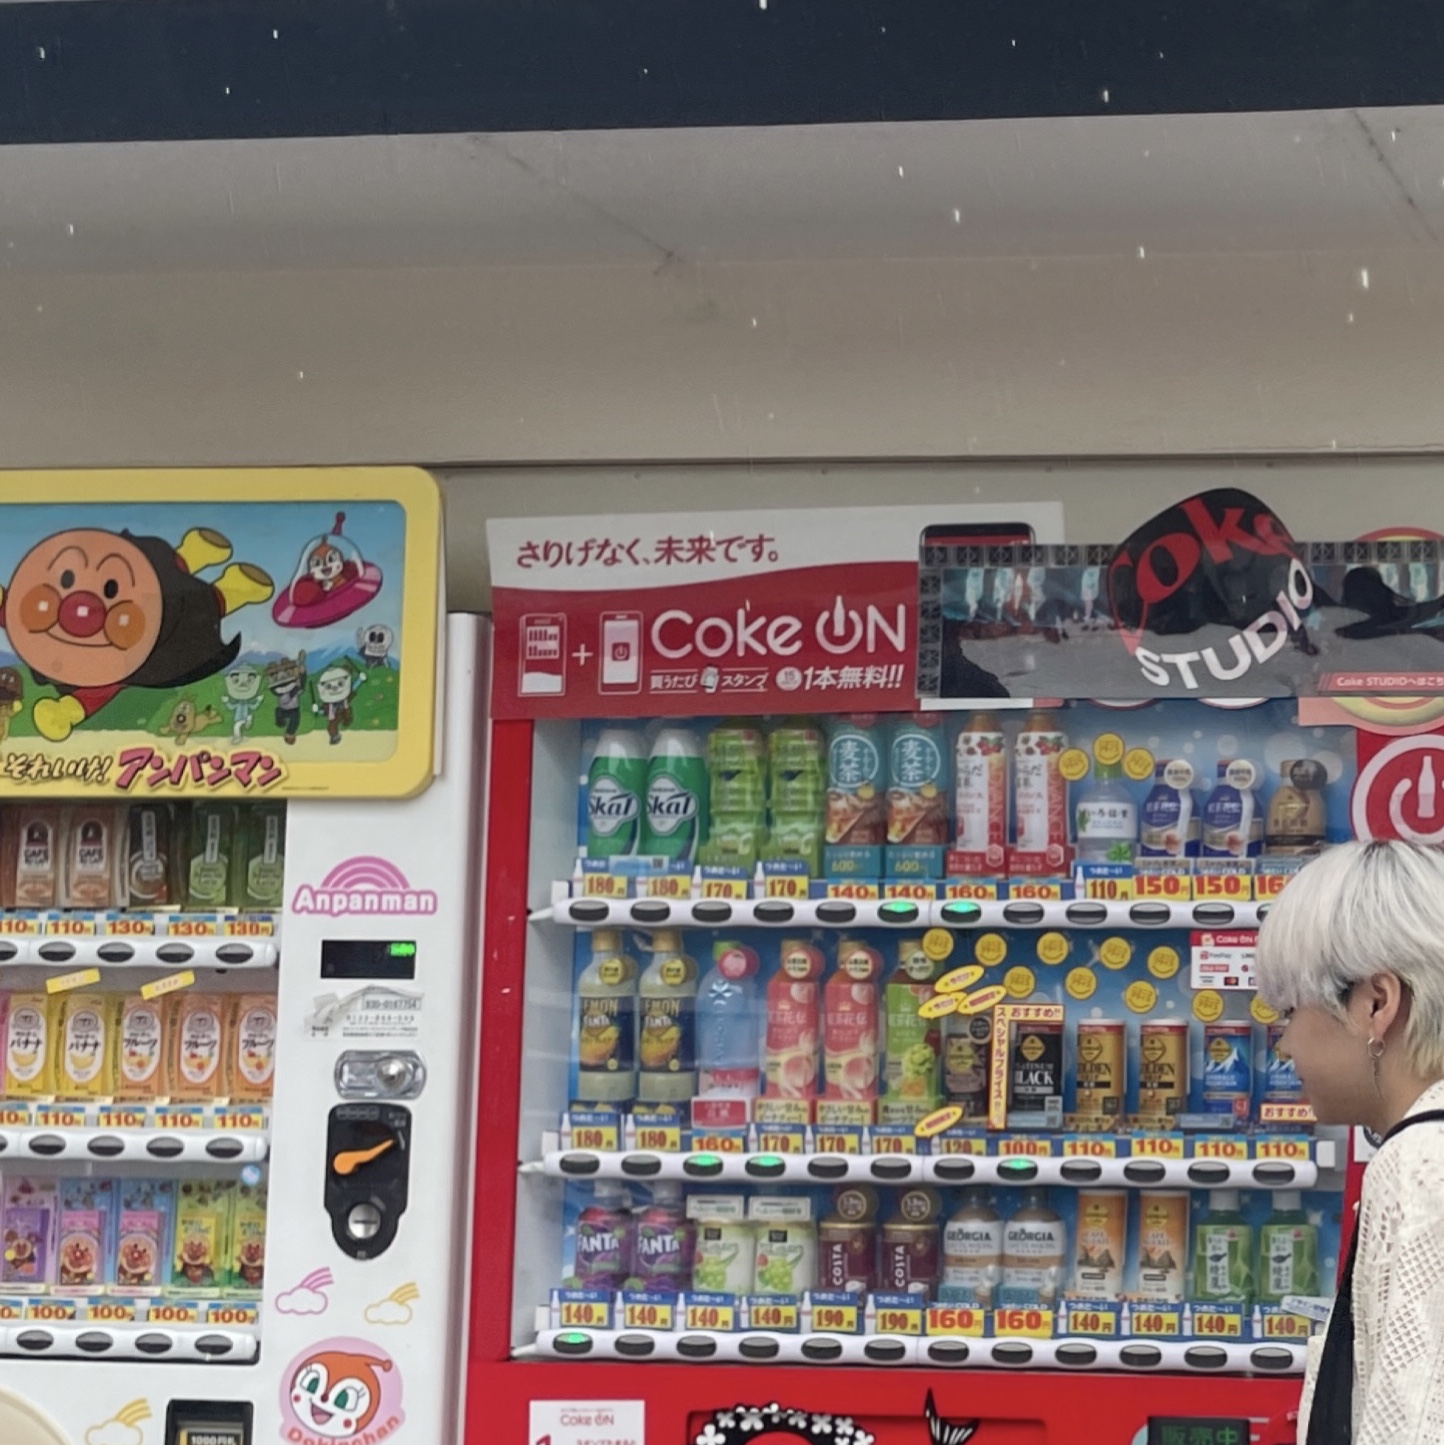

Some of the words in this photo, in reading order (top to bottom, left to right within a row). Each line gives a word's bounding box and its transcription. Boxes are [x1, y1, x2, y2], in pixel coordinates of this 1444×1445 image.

[516, 534, 779, 569] さりげなく、未来です。
[651, 607, 803, 660] Coke
[815, 595, 906, 655] ON
[1134, 557, 1314, 690] STUDIO
[721, 673, 770, 691] スタンプ
[804, 665, 904, 690] 1本無料!!
[1336, 676, 1363, 687] Coke
[115, 747, 282, 790] アンパンマン
[294, 887, 437, 914] Anpanman
[577, 1233, 620, 1253] FANTA
[638, 1234, 680, 1256] FANTA
[832, 1244, 844, 1286] COSTA
[894, 1245, 906, 1288] COSTA
[928, 1309, 983, 1330] 160円
[996, 1311, 1051, 1331] 160円
[1070, 1314, 1113, 1334] 140円
[1133, 1314, 1176, 1334] 140円
[1195, 1316, 1238, 1335] 140円
[1265, 1316, 1309, 1336] 140円
[560, 1412, 593, 1427] Coke
